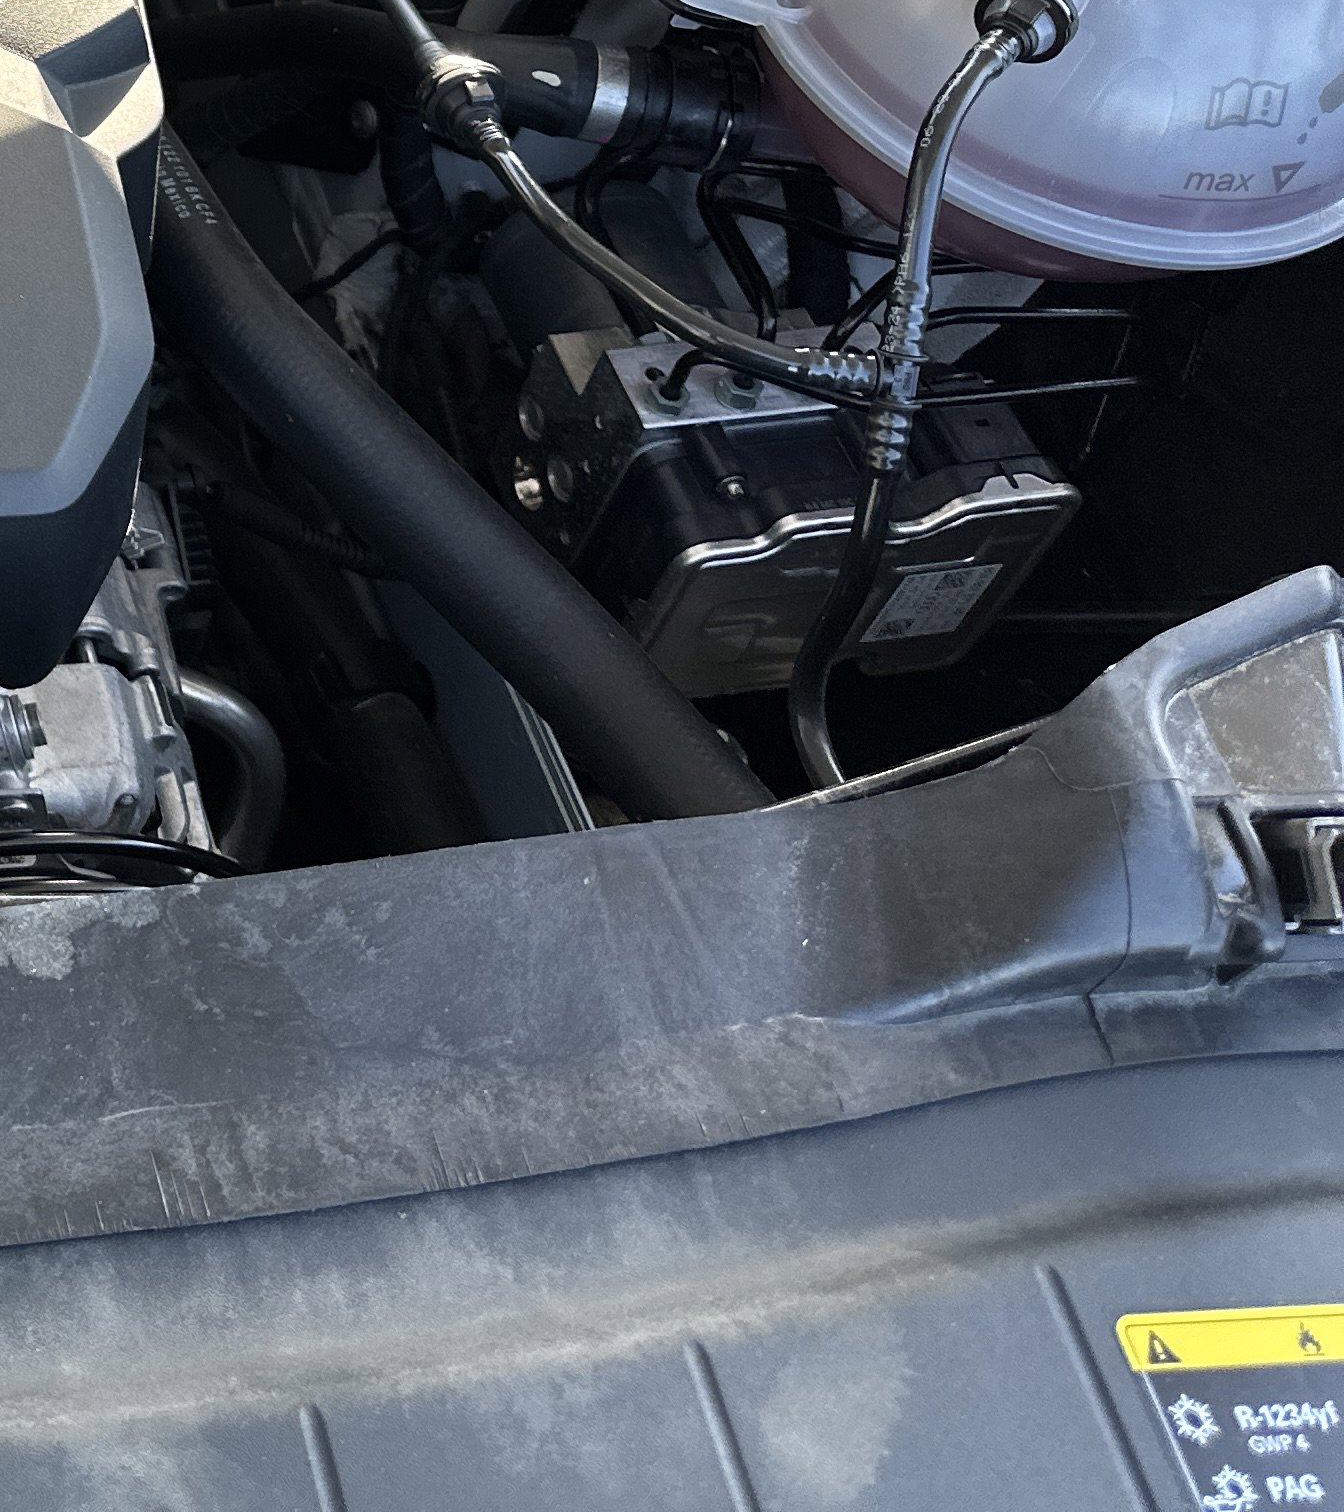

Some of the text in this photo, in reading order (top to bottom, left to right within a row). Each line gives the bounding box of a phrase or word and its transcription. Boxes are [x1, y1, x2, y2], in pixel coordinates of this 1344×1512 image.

[1183, 165, 1258, 193] max
[1233, 1400, 1340, 1433] R-1234yf
[1248, 1435, 1292, 1455] GWP
[1265, 1473, 1325, 1503] PAG
